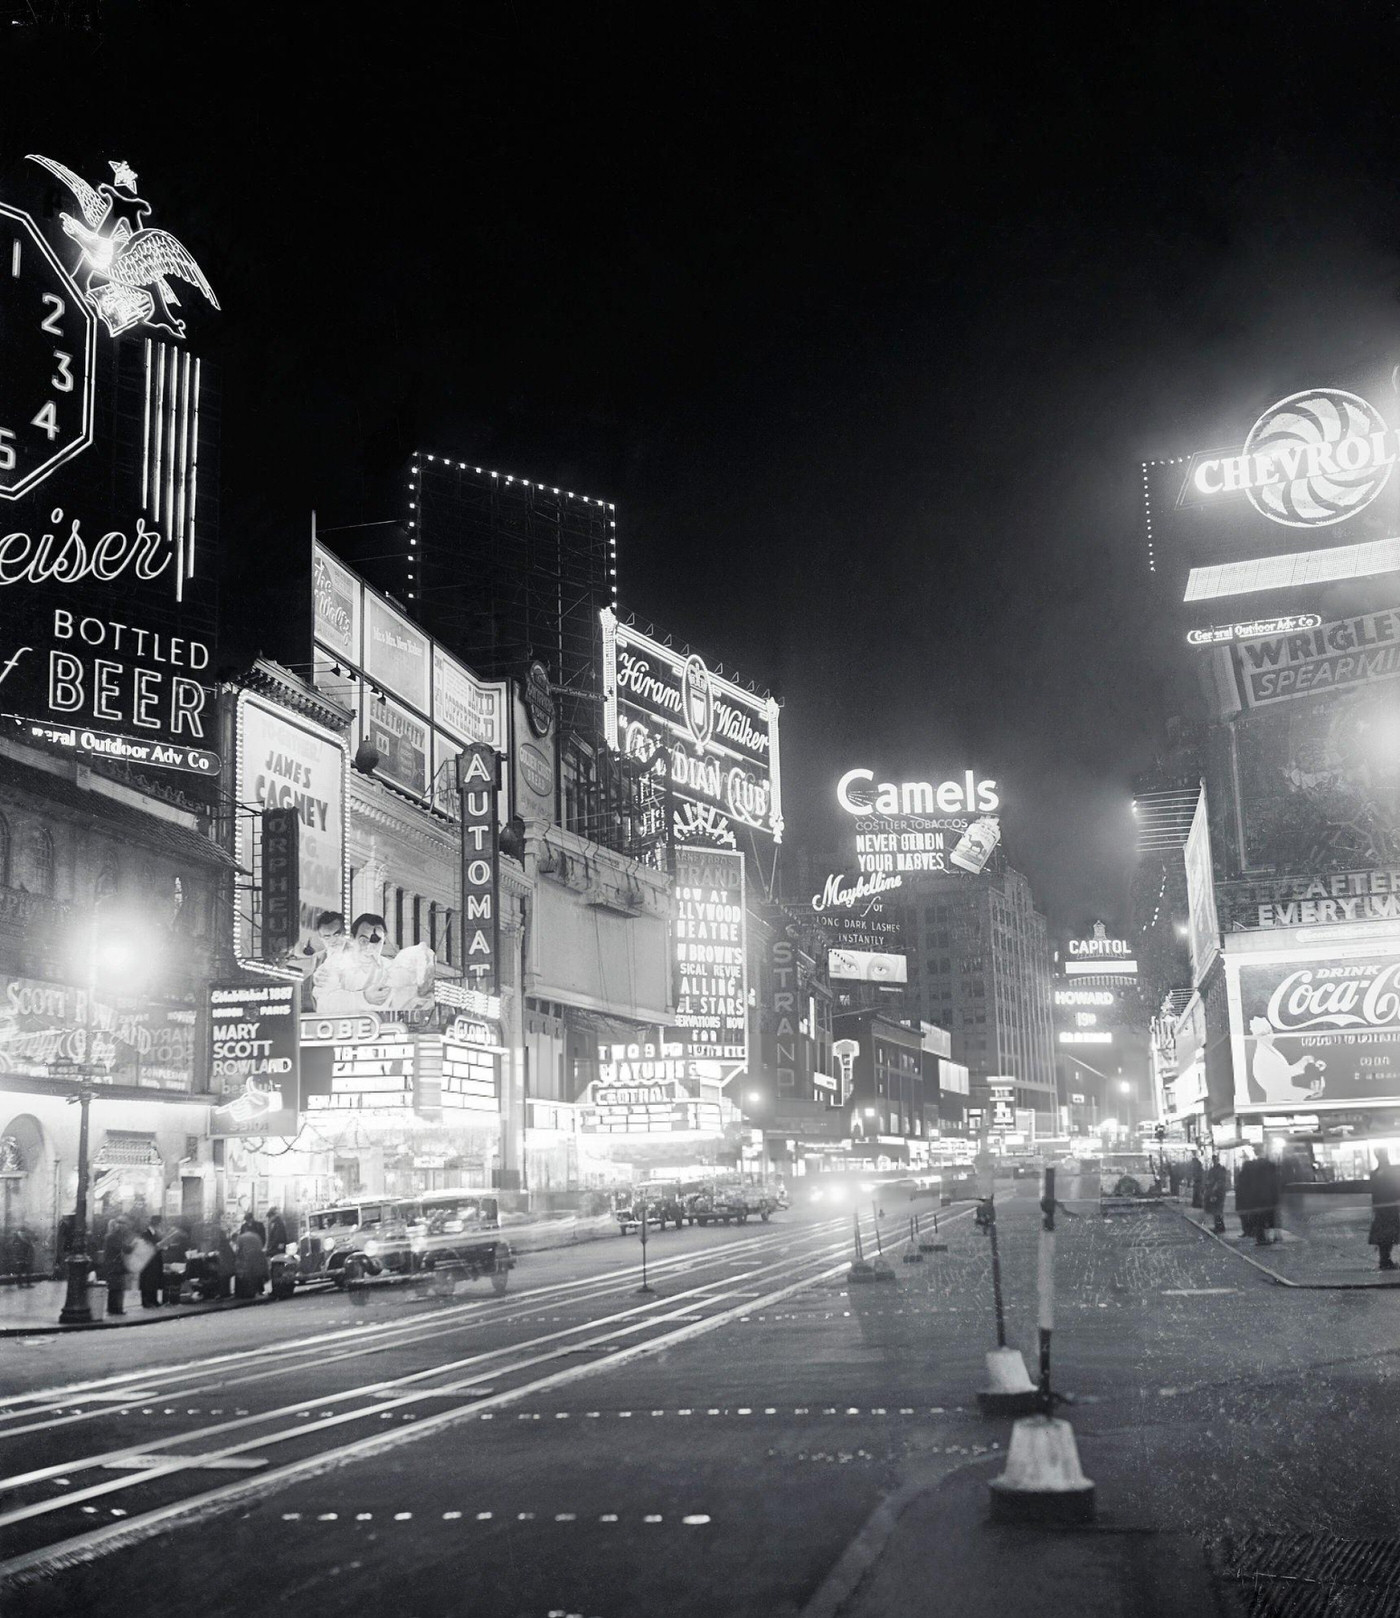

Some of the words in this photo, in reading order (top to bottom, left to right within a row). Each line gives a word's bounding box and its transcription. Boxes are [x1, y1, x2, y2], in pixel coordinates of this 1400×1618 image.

[41, 293, 65, 336] 2
[51, 352, 74, 392] 3
[30, 400, 60, 440] 4
[1194, 428, 1400, 494] CHEVROL
[54, 609, 209, 669] BOTTLED
[49, 650, 205, 738] BEER
[617, 652, 683, 713] Hiram
[714, 700, 770, 753] Walker
[81, 732, 151, 759] Outdoor
[151, 745, 183, 765] Adv
[187, 750, 209, 770] Co
[264, 751, 312, 789] JAMES
[255, 775, 328, 833] CAGNEY
[837, 768, 1000, 816] Camels
[855, 820, 907, 832] COSTLIER
[910, 818, 968, 831] TOBACCOS
[856, 833, 898, 853] NEVER
[464, 753, 491, 977] AUTOMAT
[858, 854, 894, 873] YOUR
[710, 890, 728, 903] AT
[812, 873, 903, 911] Maybelline
[838, 933, 885, 946] INSTANTLY
[844, 919, 867, 930] DARK
[1069, 940, 1132, 954] CAPITOL
[713, 964, 741, 978] REVUE
[1316, 965, 1382, 980] DRINK
[7, 982, 65, 1018] SCOTT
[260, 1004, 291, 1016] PARIS
[700, 997, 744, 1016] STARS
[772, 941, 795, 1089] STRAND
[1267, 961, 1400, 1031] Coca-C
[213, 1022, 260, 1041] MARY
[213, 1040, 274, 1058] SCOTT
[213, 1057, 292, 1077] ROWLAND
